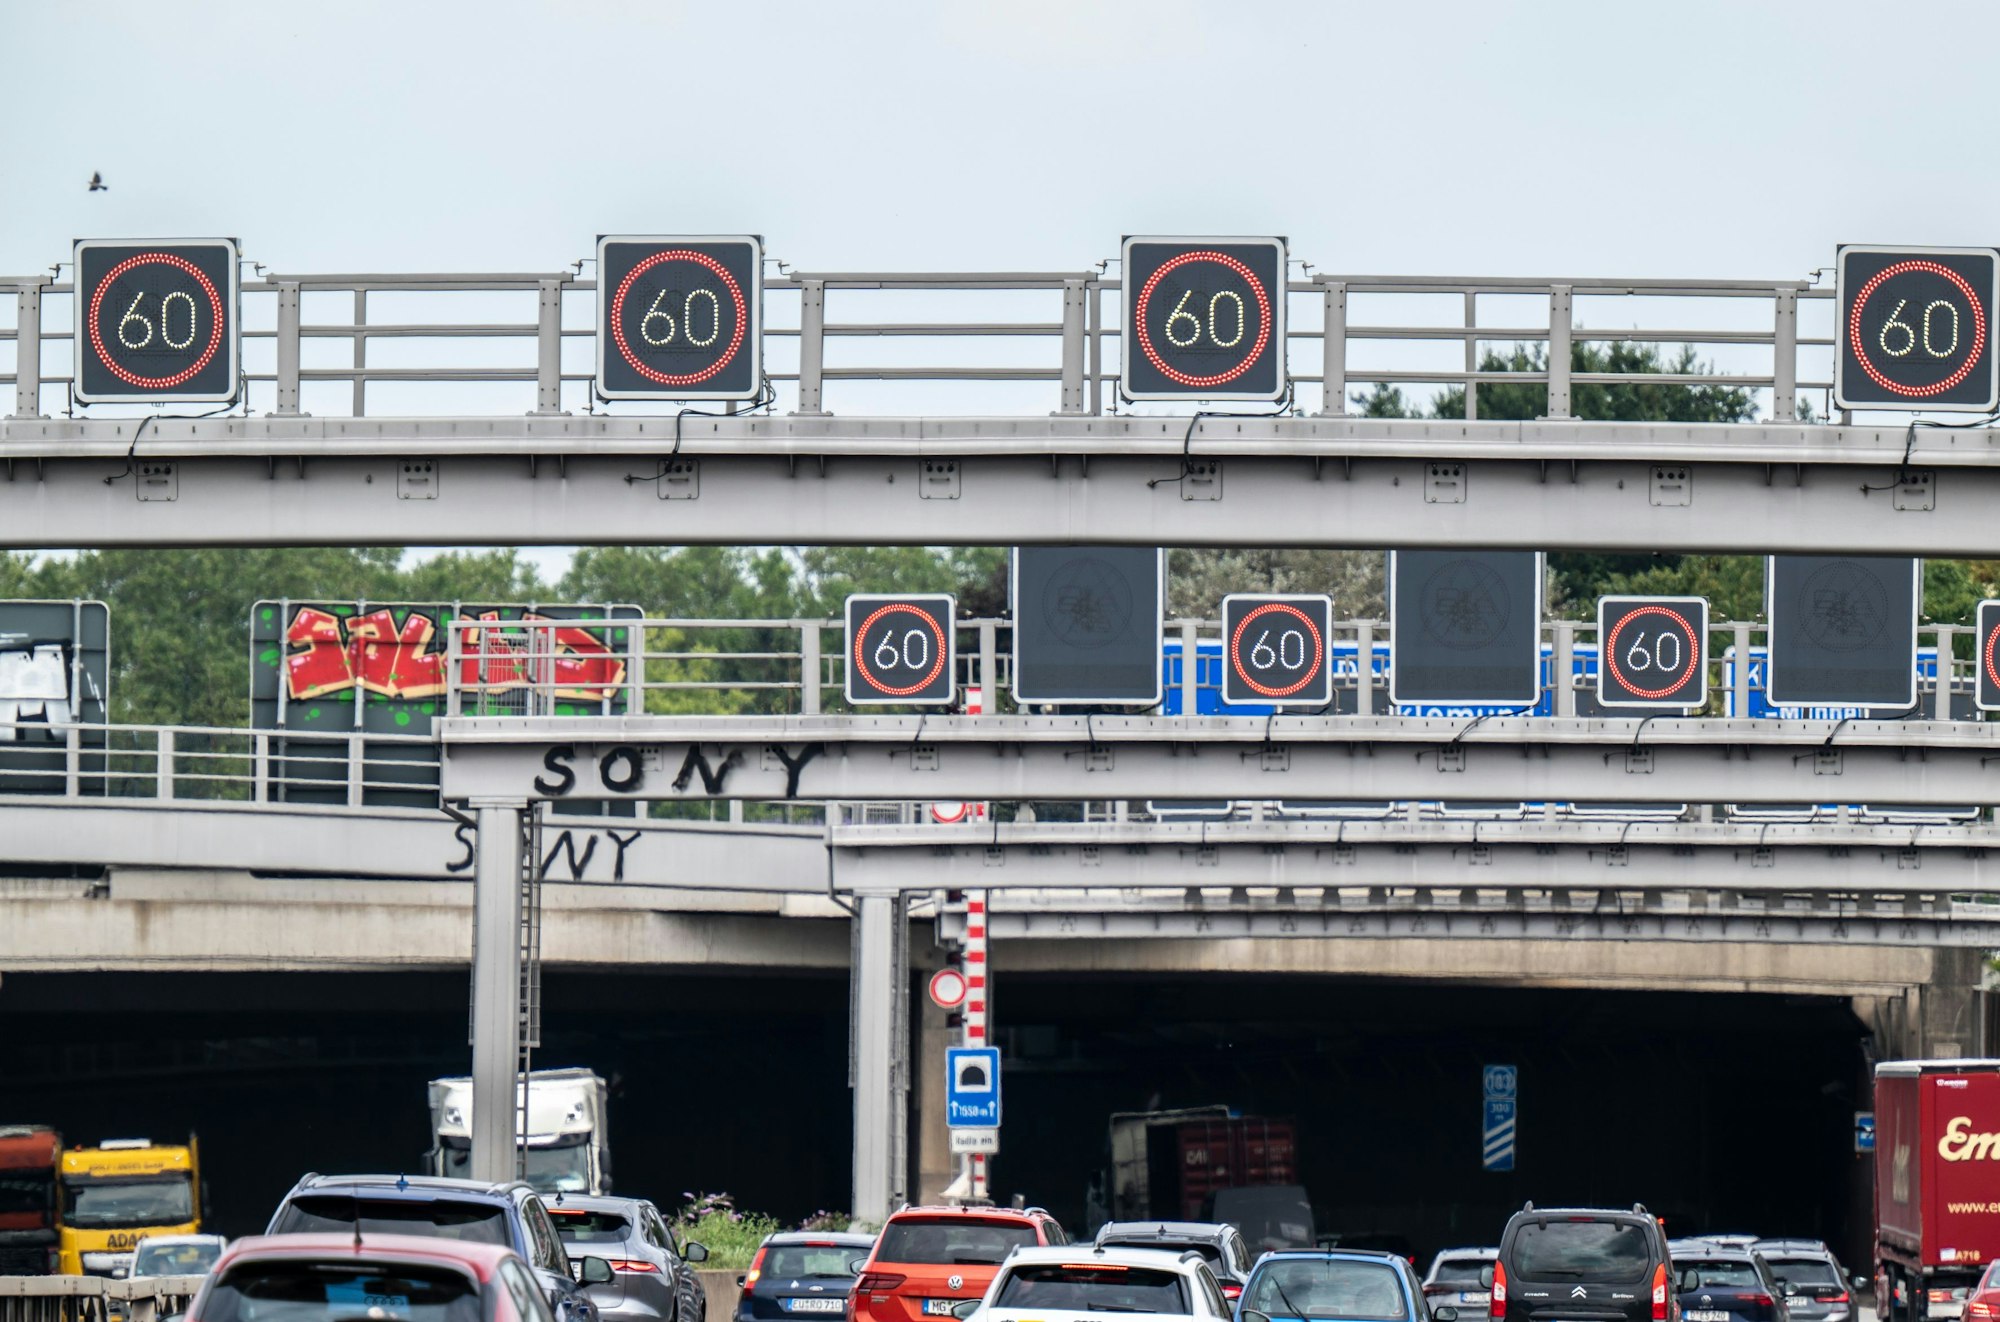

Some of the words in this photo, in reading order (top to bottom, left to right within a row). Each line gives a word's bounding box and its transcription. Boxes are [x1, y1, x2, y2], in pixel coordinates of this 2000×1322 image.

[117, 290, 198, 350] 60
[640, 288, 720, 348] 60
[1165, 289, 1246, 348] 60
[1879, 299, 1959, 358] 60
[874, 629, 928, 670] 60
[1251, 629, 1305, 670] 60
[1627, 631, 1681, 672] 60
[534, 744, 824, 798] SONY
[446, 824, 642, 882] SNY
[1947, 1202, 2000, 1214] www.e
[107, 1233, 150, 1248] ADA
